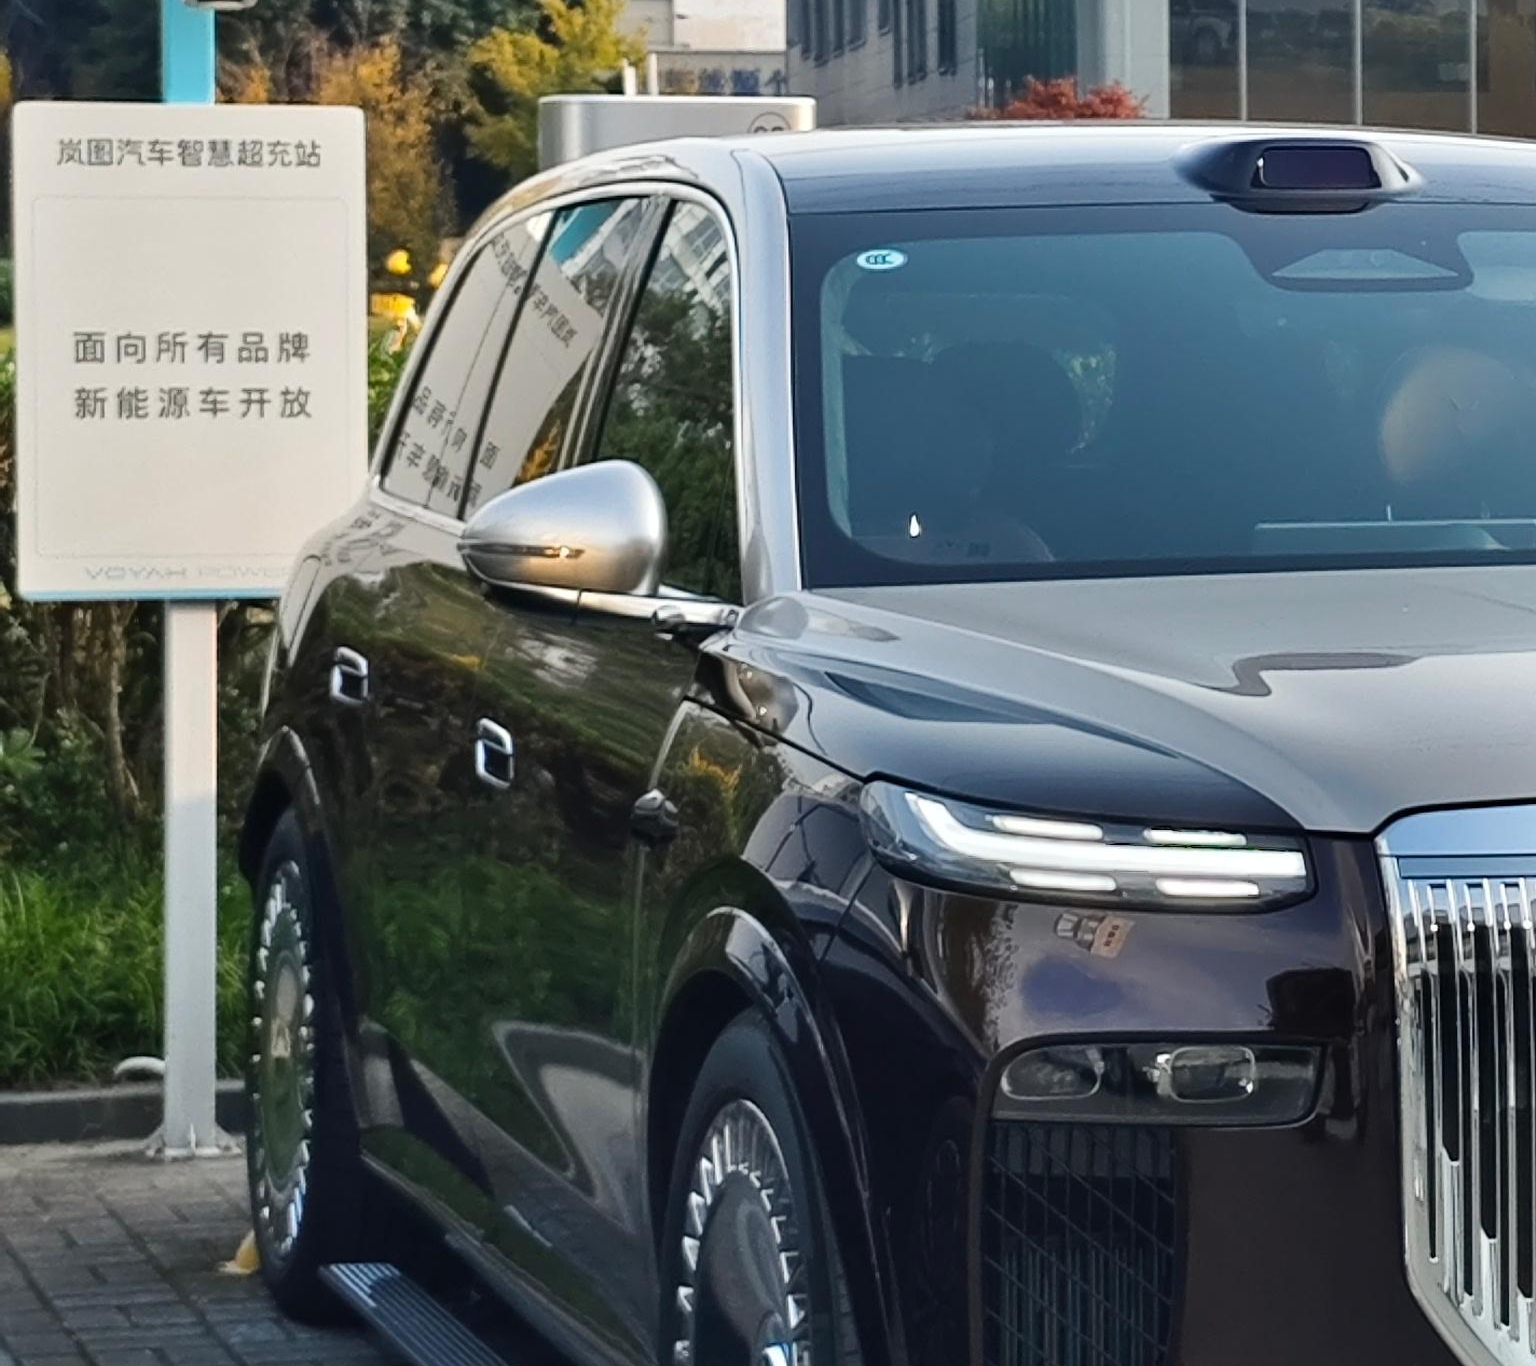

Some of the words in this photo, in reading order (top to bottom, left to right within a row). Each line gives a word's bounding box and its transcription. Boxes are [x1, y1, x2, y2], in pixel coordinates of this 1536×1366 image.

[57, 138, 321, 167] 岚图汽车智慧超充站
[74, 331, 310, 365] 面向所有品牌
[74, 386, 312, 420] 新能源车开放
